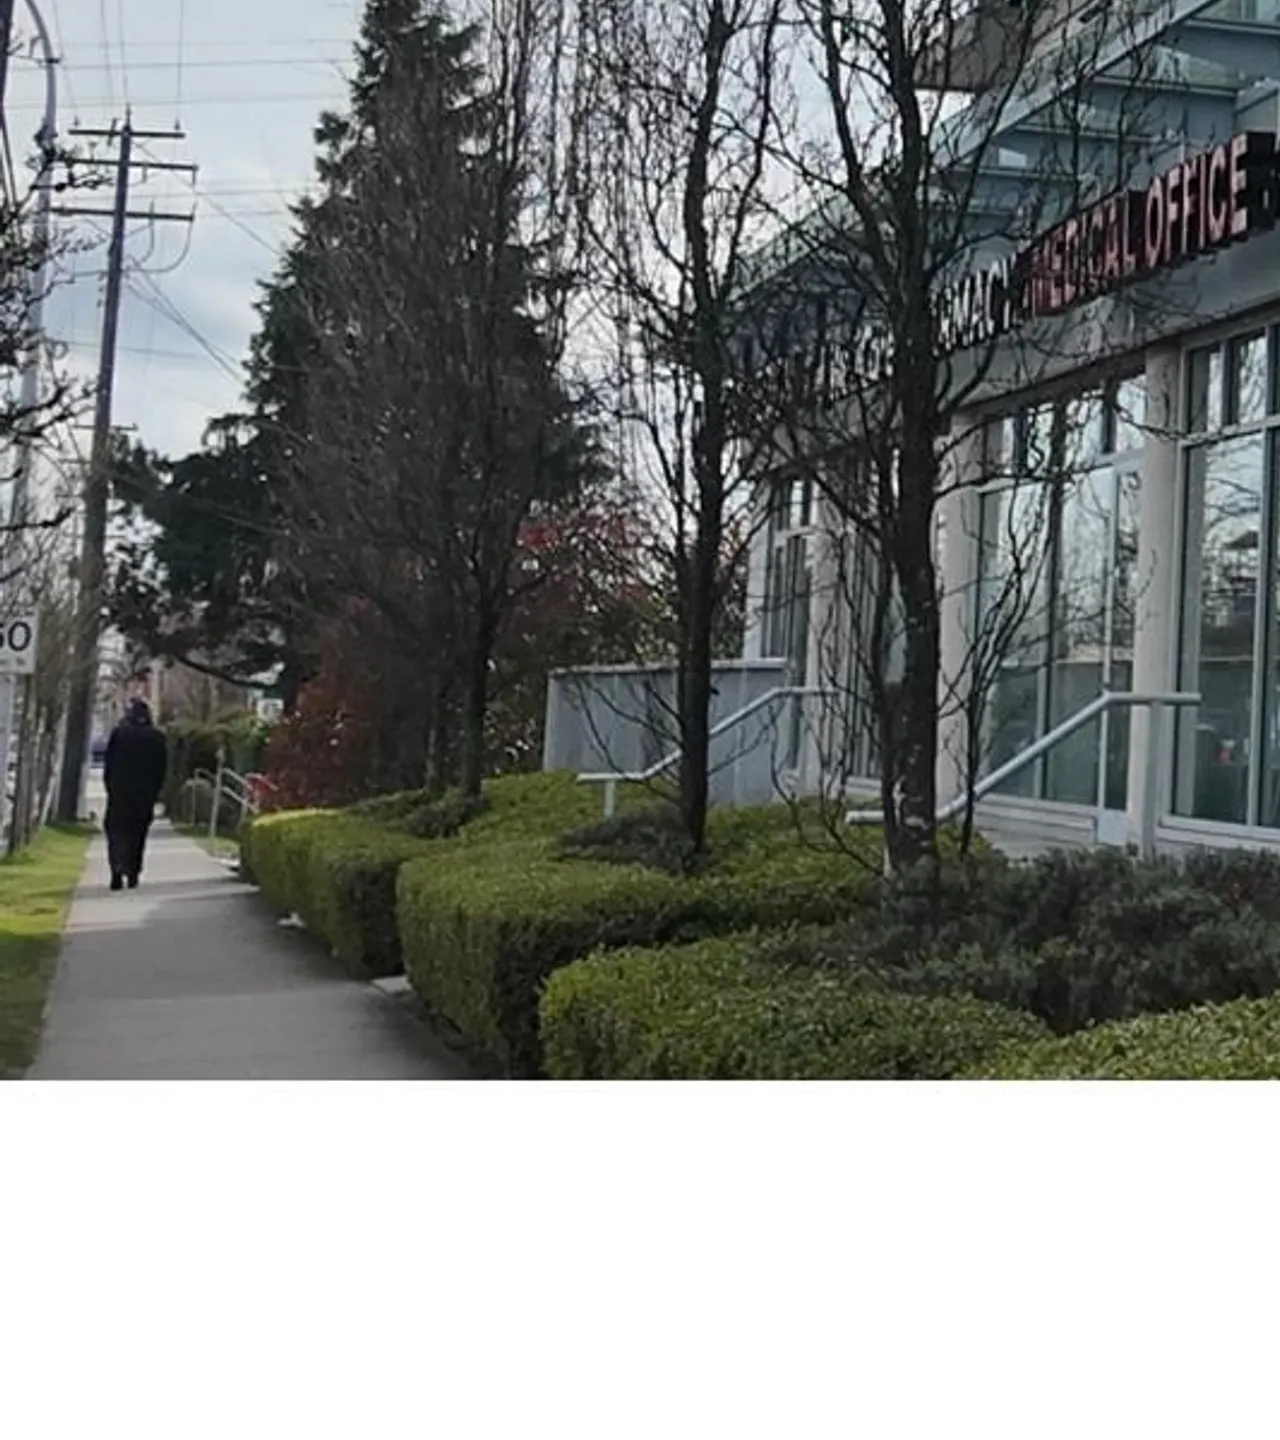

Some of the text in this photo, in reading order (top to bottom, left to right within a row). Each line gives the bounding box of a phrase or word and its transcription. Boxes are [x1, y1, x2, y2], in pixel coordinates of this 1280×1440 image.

[1029, 133, 1248, 312] MEDICAL OFFICE
[0, 621, 32, 652] 0
